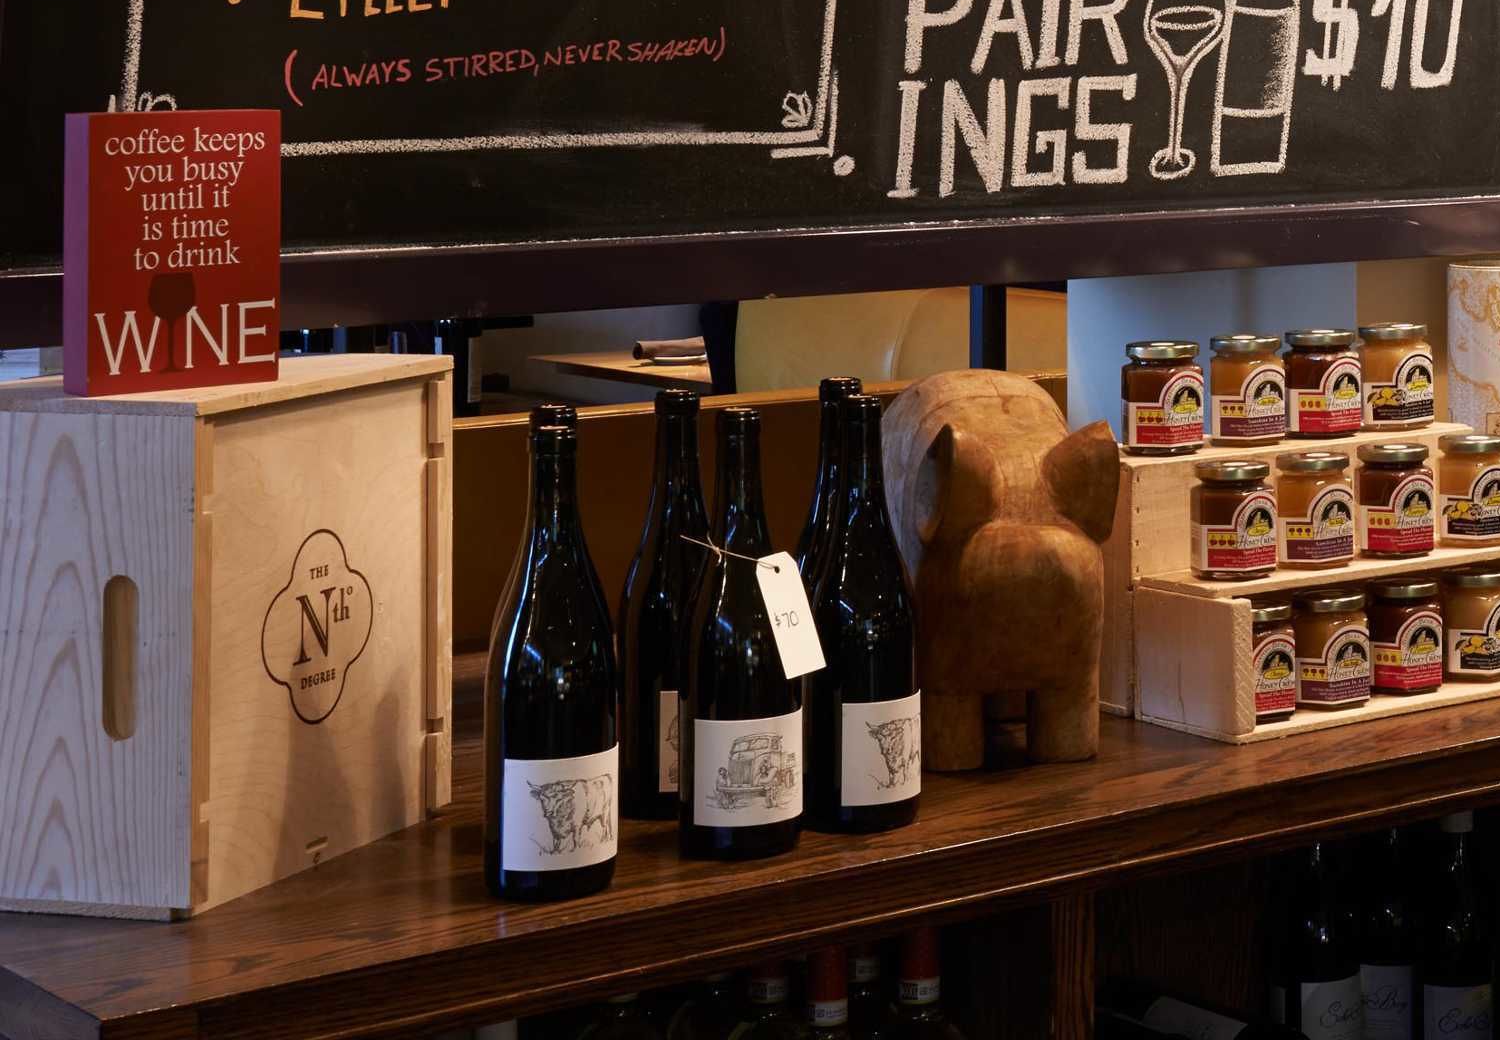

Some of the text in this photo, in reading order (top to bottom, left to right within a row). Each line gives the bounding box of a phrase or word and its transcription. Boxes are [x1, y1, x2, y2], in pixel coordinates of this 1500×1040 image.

[105, 126, 266, 158] coffee keeps
[886, 73, 1139, 199] INGS
[124, 155, 245, 192] you busy
[142, 183, 232, 212] until it
[143, 214, 230, 241] is time
[134, 239, 241, 271] to drink
[94, 297, 277, 376] WNE
[309, 564, 330, 581] THE
[300, 668, 336, 691] DEGREE
